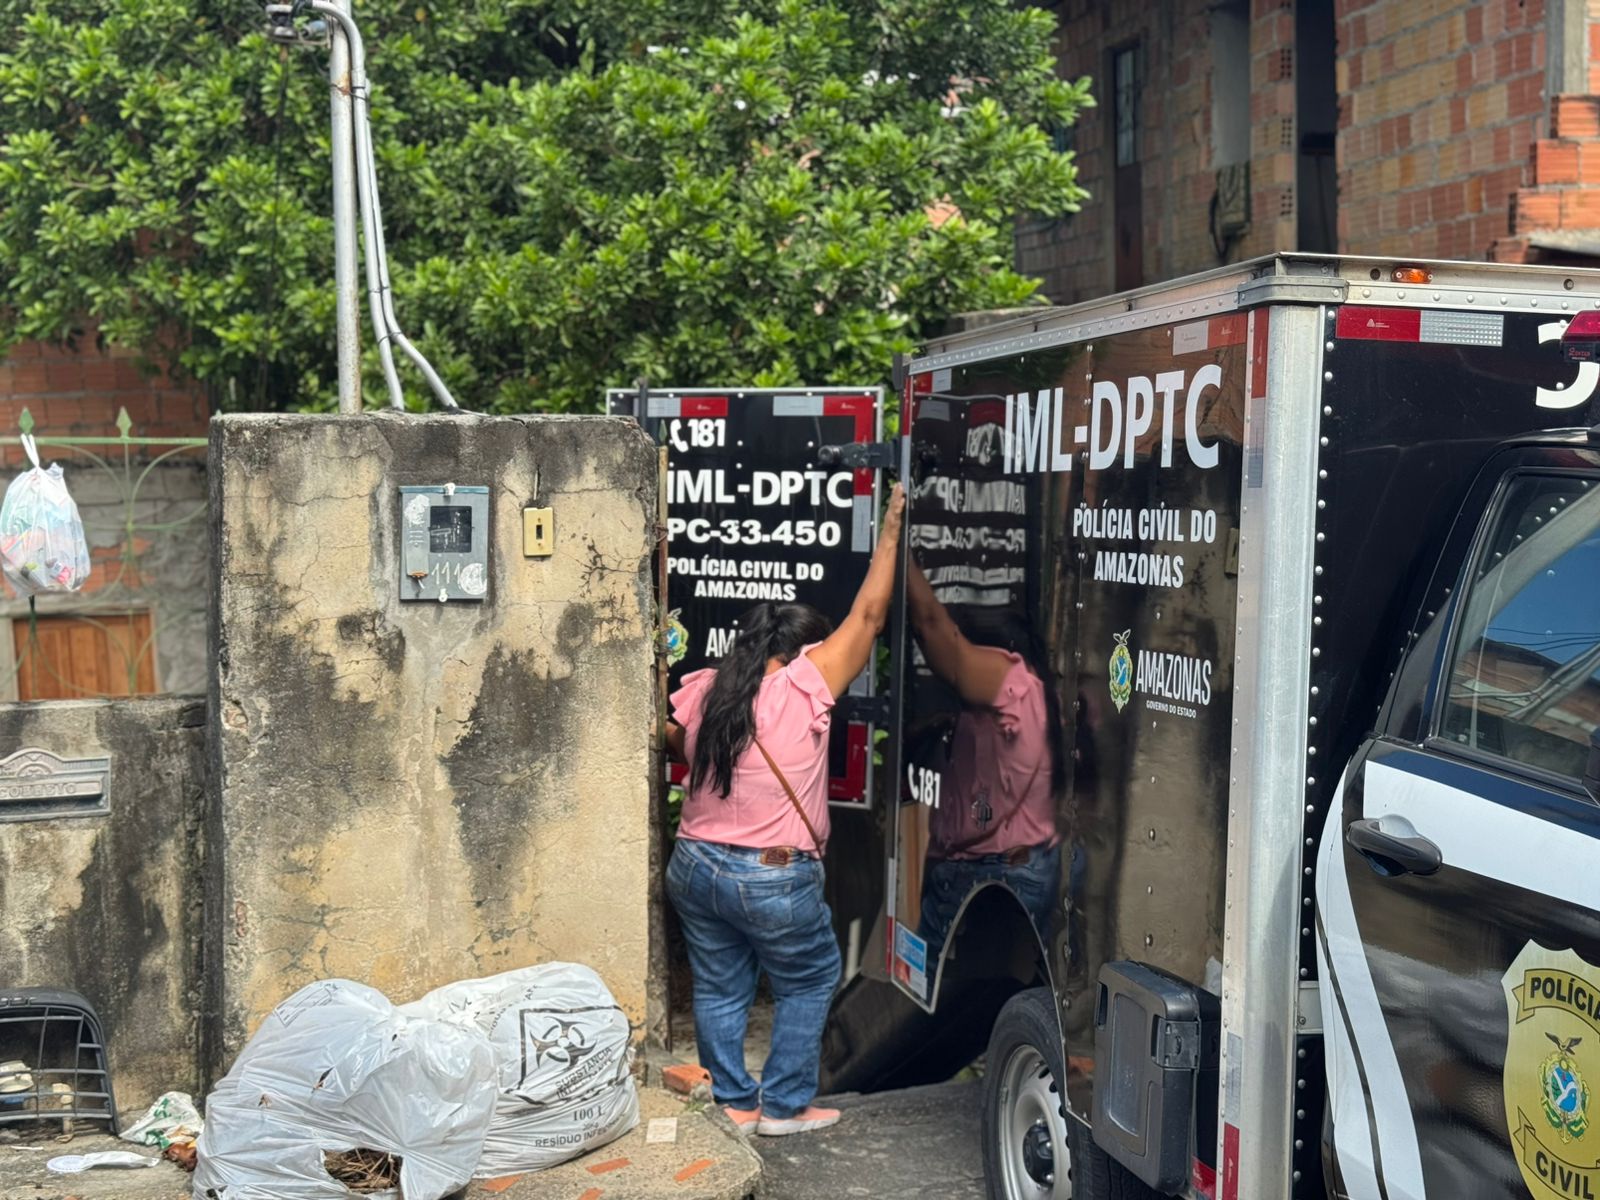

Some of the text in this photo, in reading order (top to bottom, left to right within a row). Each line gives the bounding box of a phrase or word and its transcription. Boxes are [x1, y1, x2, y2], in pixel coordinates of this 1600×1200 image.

[687, 418, 726, 447] 181
[1003, 364, 1222, 474] IML-DPTC
[667, 469, 854, 508] IML-DPTC
[667, 518, 841, 546] PC-33.450
[1072, 499, 1217, 544] POLÍCIA CIVIL DO
[667, 554, 824, 581] POLÍCIA CIVIL DO
[1093, 551, 1185, 589] AMAZONAS
[694, 580, 797, 601] AMAZONAS
[1135, 649, 1212, 706] AMAZONAS
[1146, 700, 1197, 718] GOVERNO DO ESTADO
[918, 767, 941, 808] 181
[1535, 1151, 1594, 1200] CIVIL
